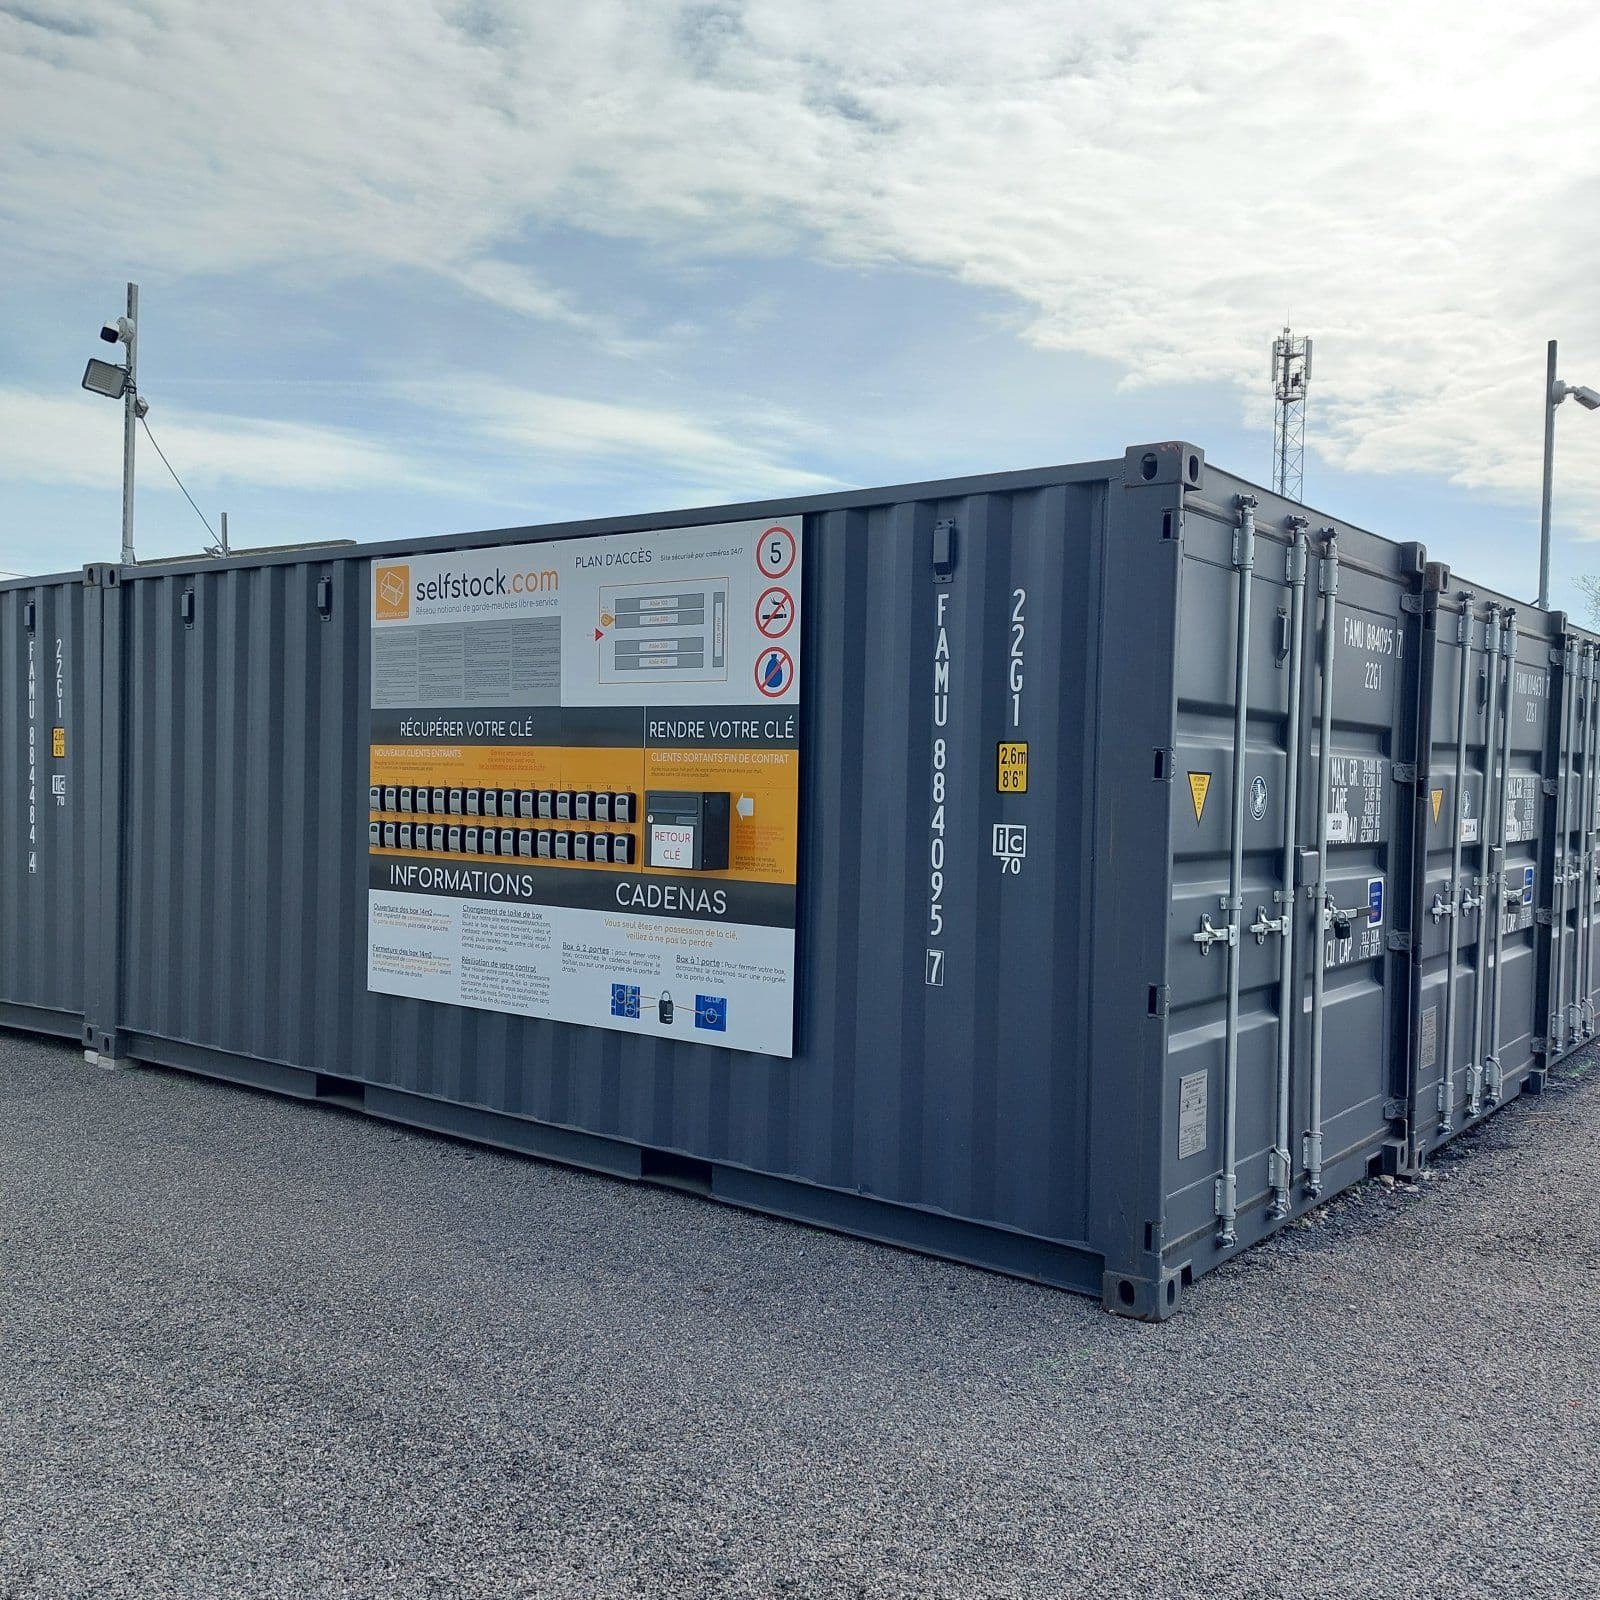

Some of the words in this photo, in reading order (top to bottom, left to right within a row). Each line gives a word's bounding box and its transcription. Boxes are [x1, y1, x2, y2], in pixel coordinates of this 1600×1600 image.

[576, 556, 602, 568] PLAN
[606, 547, 652, 566] D'ACCÈS
[705, 550, 730, 558] caméras
[770, 542, 782, 563] 5
[416, 567, 559, 601] selfstock.com
[437, 604, 462, 614] national
[463, 604, 471, 612] de
[471, 600, 518, 613] garde-meubles
[519, 597, 558, 608] libre-service
[1344, 617, 1364, 648] FAMU
[1366, 623, 1393, 655] 884095
[934, 593, 950, 727] FAMU
[1010, 588, 1026, 727] 22G1
[1364, 662, 1382, 691] 22G1
[400, 716, 463, 736] RÉCUPÉRER
[466, 721, 506, 736] VOTRE
[509, 716, 533, 736] CLÉ
[650, 721, 705, 738] RENDRE
[709, 721, 760, 738] VOTRE
[764, 715, 794, 738] CLÉ
[407, 749, 430, 757] CLIENTS
[651, 752, 681, 762] CLIENTS
[683, 753, 722, 763] SORTANTS
[739, 753, 749, 763] DE
[751, 754, 789, 764] CONTRAT
[1001, 747, 1027, 767] 2,6m
[1331, 787, 1348, 815] TARE
[654, 831, 691, 843] RETOUR
[930, 738, 946, 936] 884095
[663, 848, 681, 860] CLÉ
[1000, 857, 1021, 875] 70
[390, 864, 533, 897] INFORMATIONS
[615, 882, 727, 914] CADENAS
[462, 904, 498, 915] Changement
[522, 910, 531, 918] de
[532, 911, 542, 920] box
[604, 919, 620, 928] Vous
[622, 919, 636, 929] seul
[637, 921, 652, 930] êtes
[664, 925, 704, 936] possession
[705, 929, 715, 937] de
[716, 929, 724, 937] la
[725, 930, 738, 940] clé,
[626, 931, 647, 941] veillez
[656, 935, 665, 943] ne
[665, 936, 679, 945] pas
[680, 936, 687, 945] la
[688, 938, 713, 948] perdre
[491, 960, 498, 968] de
[676, 954, 688, 963] Box
[928, 950, 943, 984] 7
